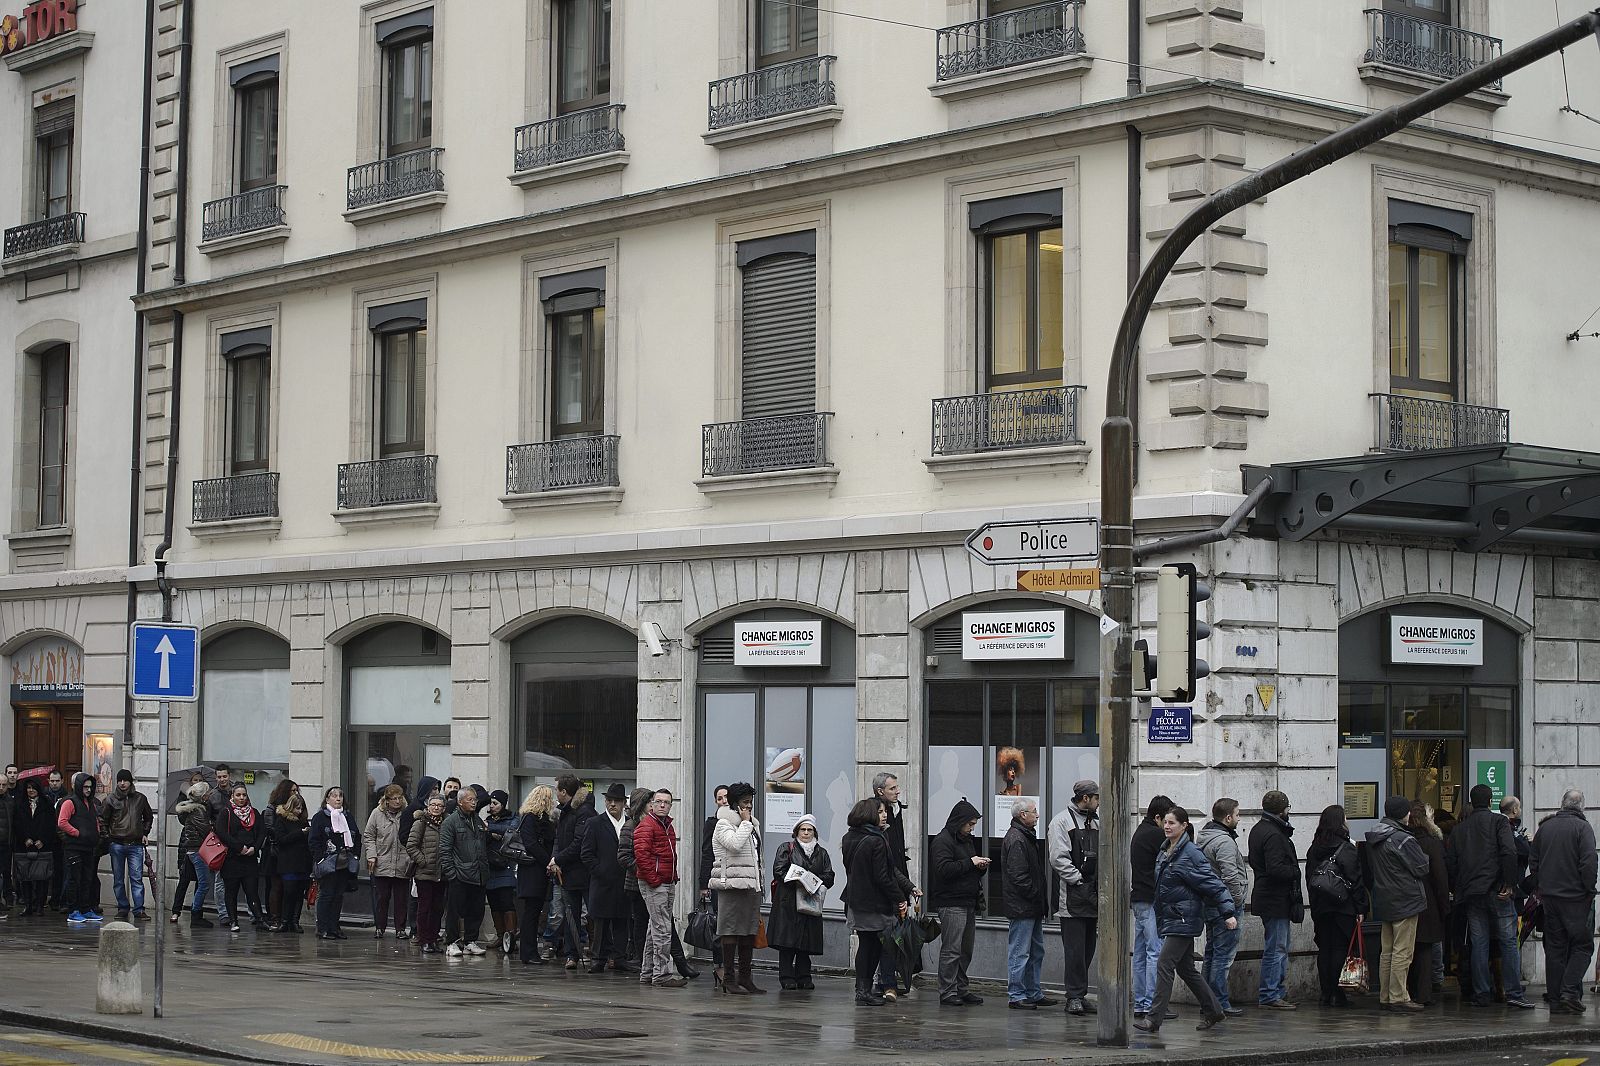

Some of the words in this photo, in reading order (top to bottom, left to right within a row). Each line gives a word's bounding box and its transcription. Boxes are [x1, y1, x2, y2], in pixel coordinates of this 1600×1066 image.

[1020, 529, 1068, 551] Police
[1032, 572, 1055, 586] Hôtel
[1060, 571, 1094, 586] Admiral
[970, 622, 1013, 635] CHANGE
[1014, 621, 1056, 634] MIGROS
[1399, 626, 1438, 638] CHANGE
[1440, 628, 1476, 640] MIGROS
[741, 631, 778, 642] CHANGE
[778, 630, 814, 641] MIGROS
[986, 642, 1015, 650] RÉFÉRENCE
[19, 683, 41, 692] Paroisse
[42, 683, 49, 691] de
[50, 683, 55, 691] la
[433, 687, 441, 704] 2
[1164, 709, 1175, 717] Rue
[1155, 716, 1184, 725] PÉCOLAT
